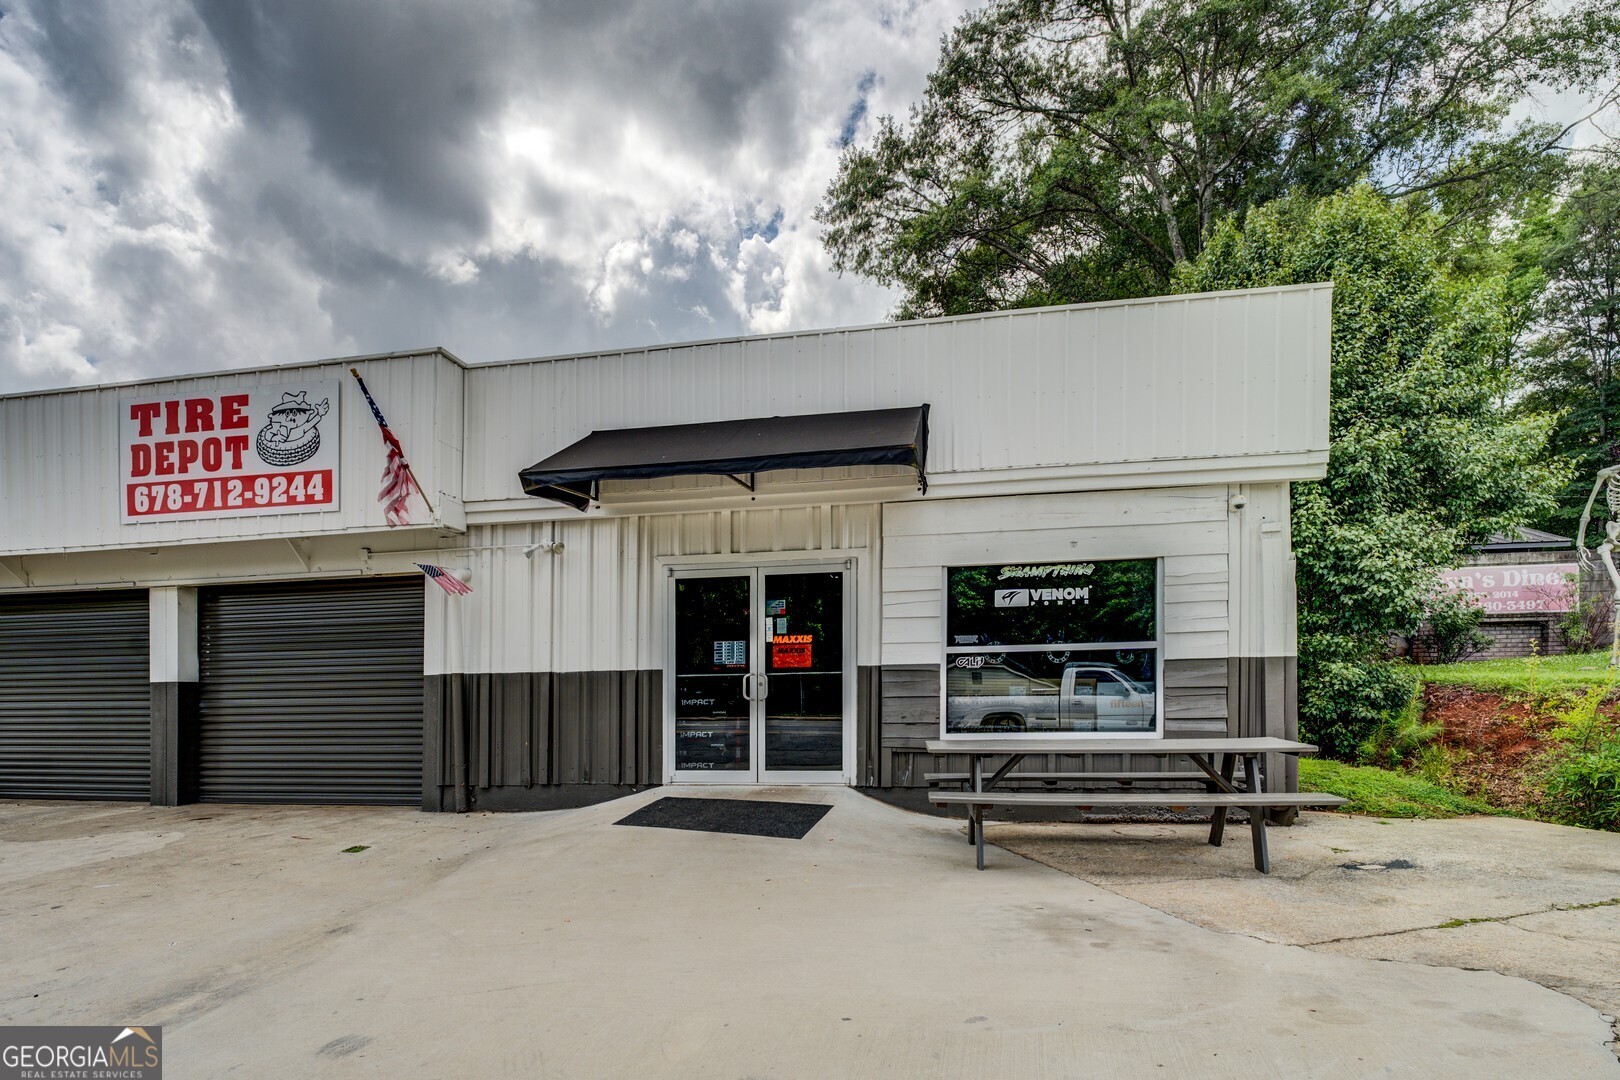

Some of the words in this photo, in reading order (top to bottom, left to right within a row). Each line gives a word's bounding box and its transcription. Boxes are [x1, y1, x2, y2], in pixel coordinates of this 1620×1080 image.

[130, 394, 249, 437] TIRE
[130, 435, 249, 478] DEPOT
[134, 473, 324, 513] 678-712-9244
[1030, 587, 1089, 601] VENOM
[1493, 590, 1519, 598] 2014
[773, 635, 813, 644] MAXXIS
[681, 698, 716, 706] IMPACT
